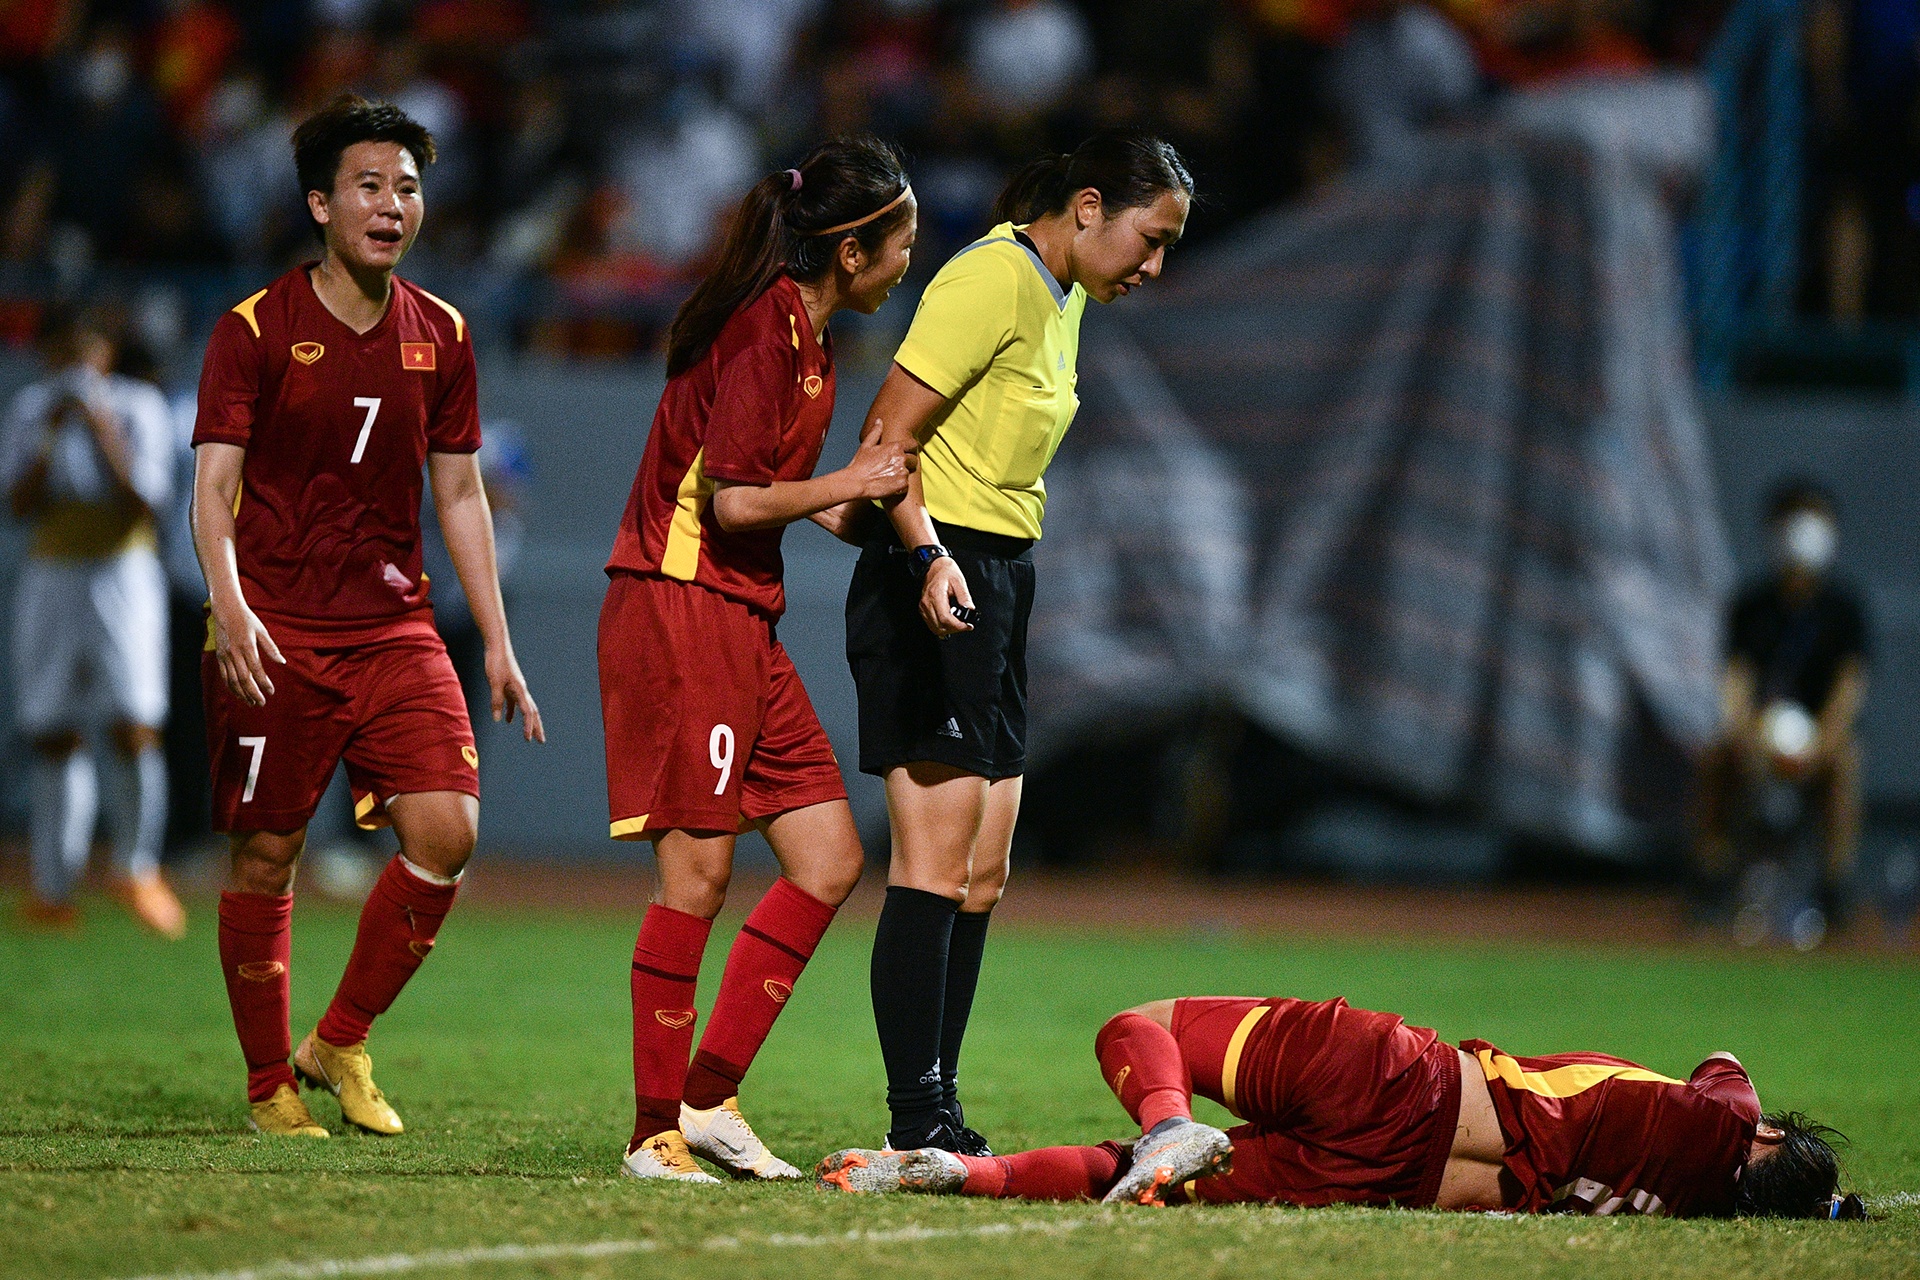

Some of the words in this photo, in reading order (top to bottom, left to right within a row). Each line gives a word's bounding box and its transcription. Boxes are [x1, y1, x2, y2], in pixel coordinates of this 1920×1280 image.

[350, 396, 382, 464] 7
[238, 736, 267, 803] 7
[709, 723, 735, 795] 9
[925, 1122, 943, 1142] adidas
